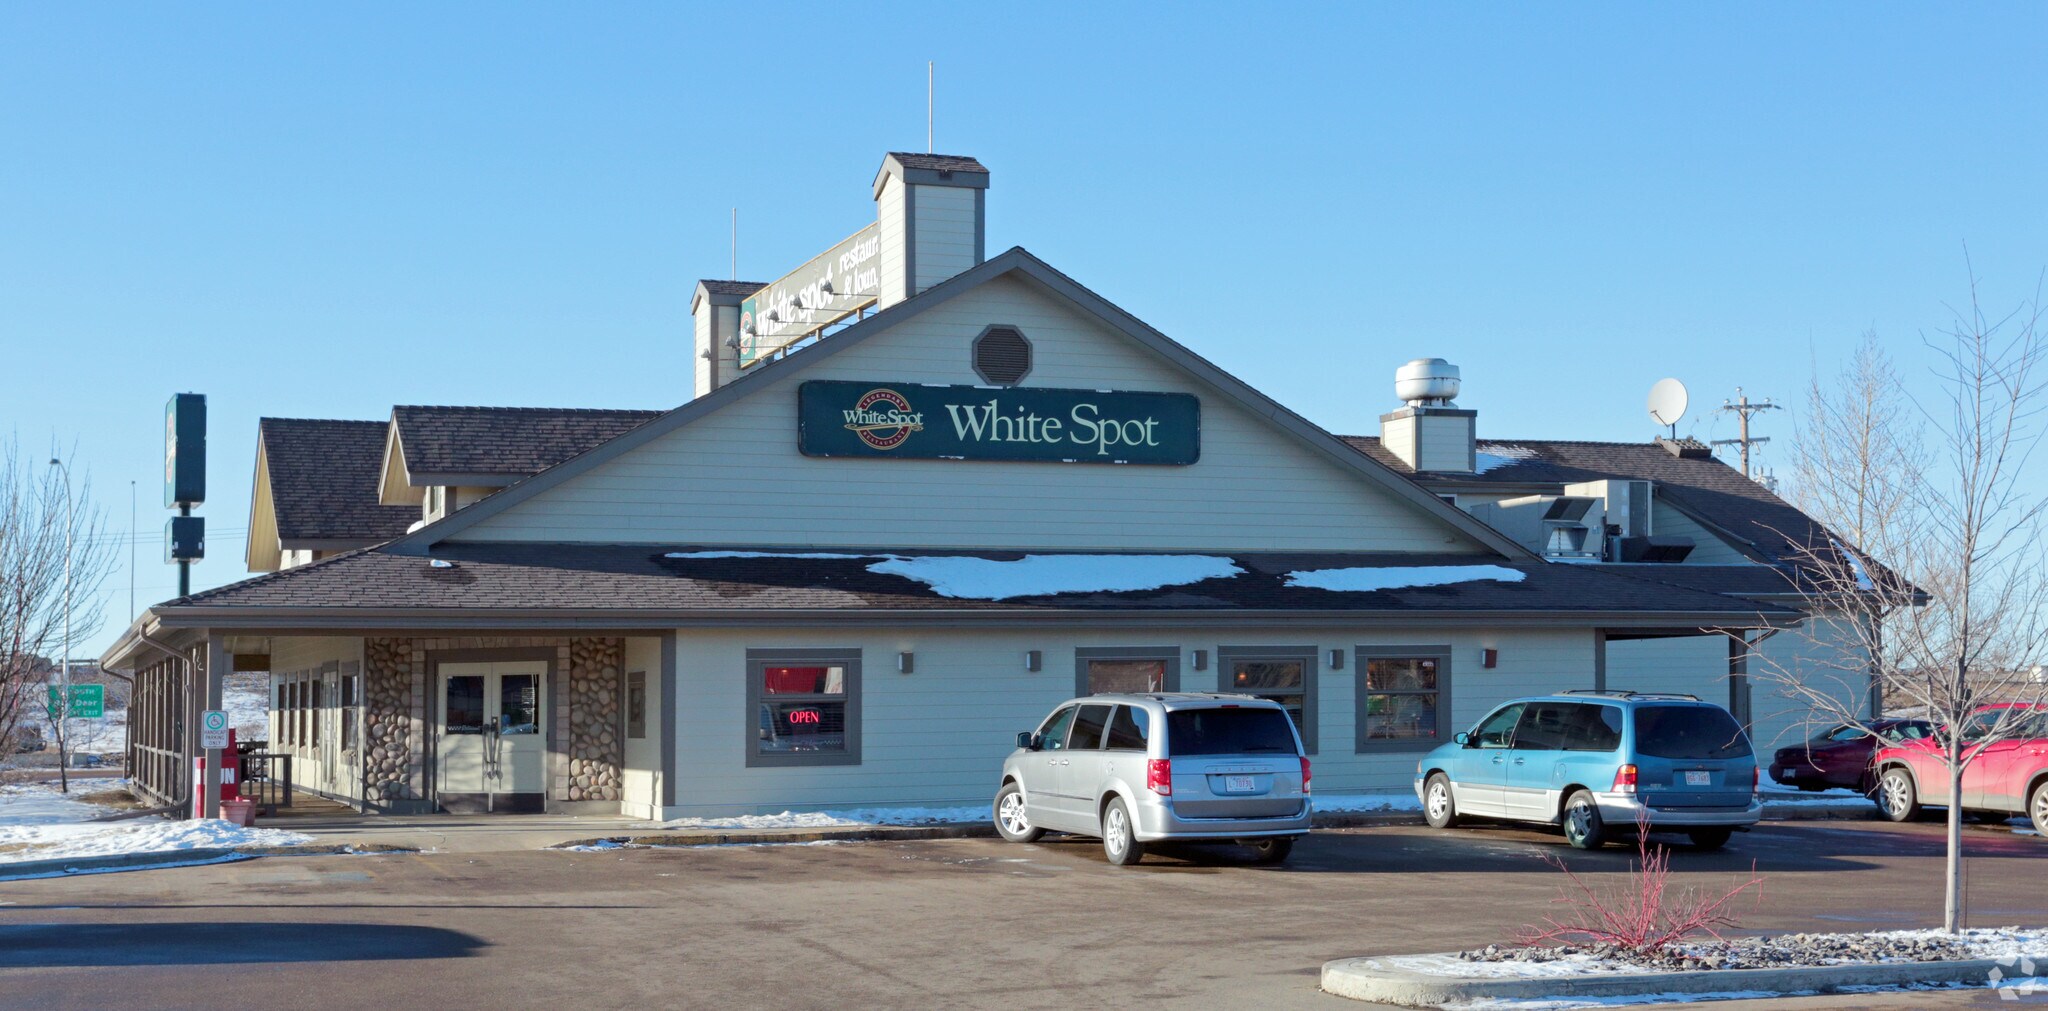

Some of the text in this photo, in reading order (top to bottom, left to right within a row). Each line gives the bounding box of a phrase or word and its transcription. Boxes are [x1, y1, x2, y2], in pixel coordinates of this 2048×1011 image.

[839, 235, 879, 274] restaur
[843, 266, 879, 301] & loun
[862, 392, 905, 407] LEGENDARY
[944, 398, 1160, 456] White Spot
[789, 711, 819, 724] OPEN
